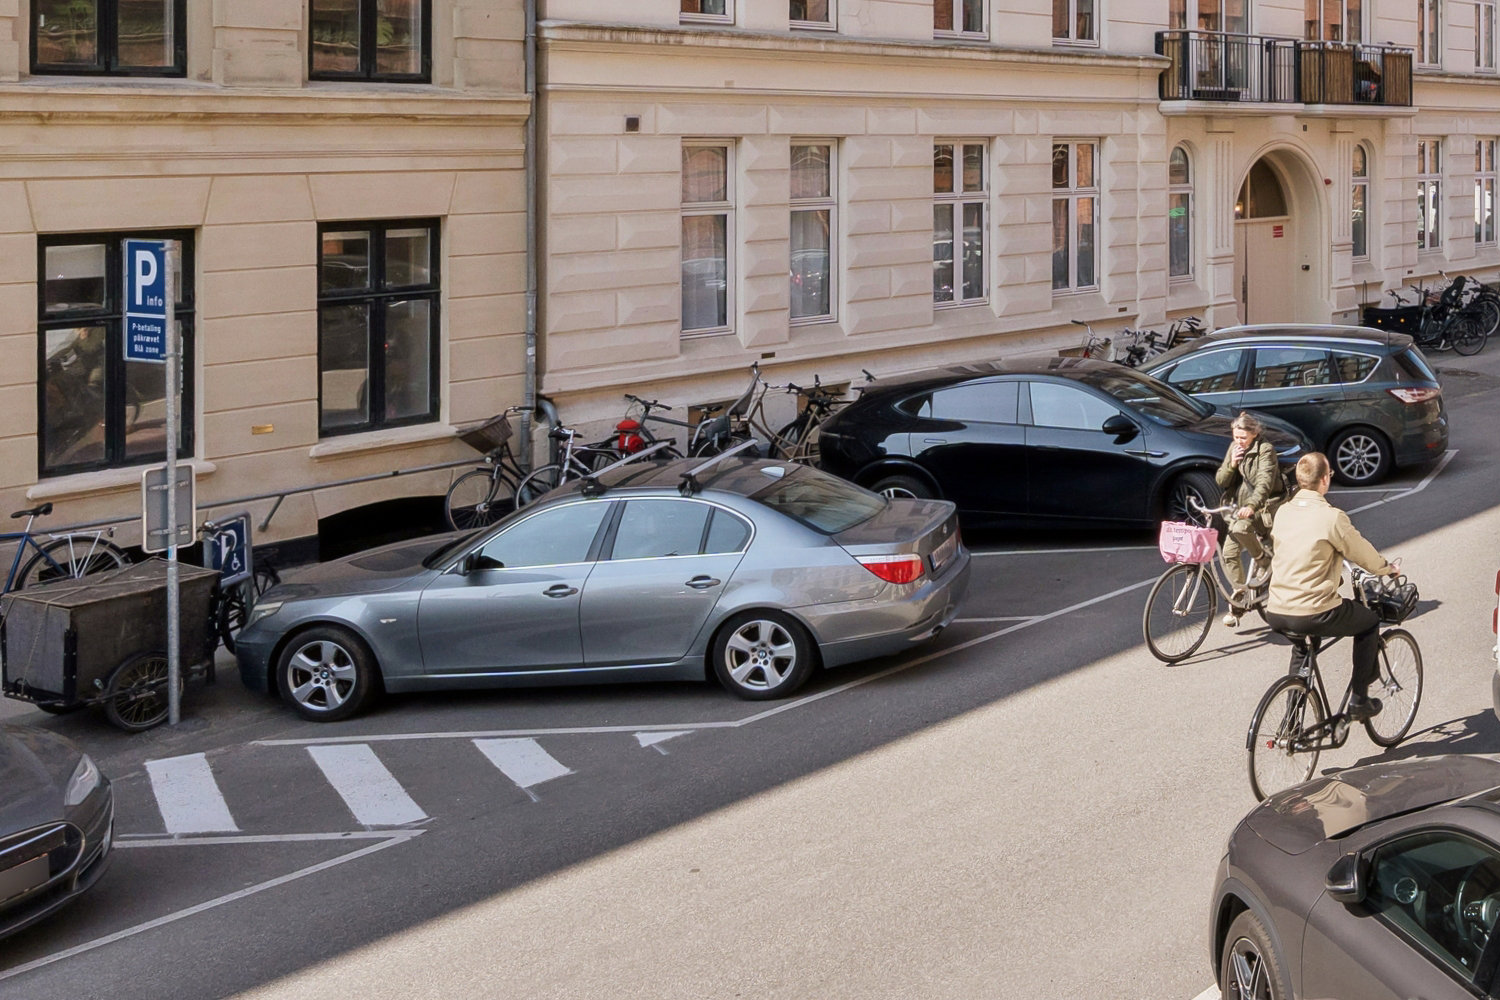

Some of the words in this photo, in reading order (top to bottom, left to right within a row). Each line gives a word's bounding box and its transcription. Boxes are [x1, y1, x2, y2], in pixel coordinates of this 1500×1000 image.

[135, 250, 157, 305] P
[146, 296, 163, 307] info
[132, 322, 161, 334] P-betaling
[145, 346, 159, 354] zone
